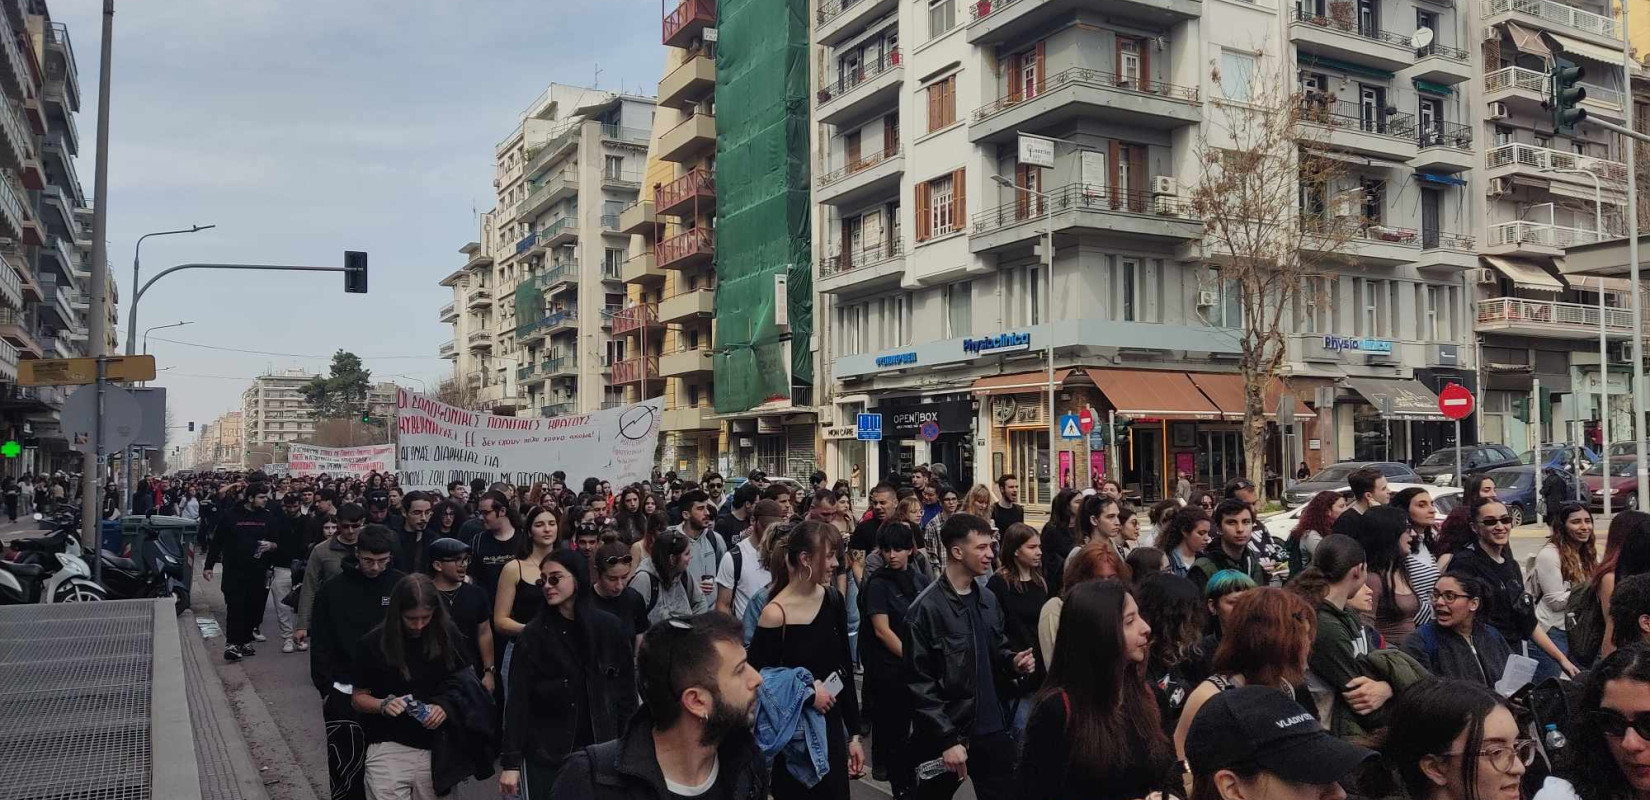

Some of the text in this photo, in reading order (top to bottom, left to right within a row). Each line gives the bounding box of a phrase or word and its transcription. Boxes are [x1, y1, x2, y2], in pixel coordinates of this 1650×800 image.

[963, 332, 1030, 353] Physioclinica
[397, 388, 408, 409] ΟΙ
[547, 414, 592, 430] ΚΡΑΤΟΥΣ
[893, 411, 938, 424] OPEN BOX
[401, 445, 429, 462] ΑΓΩΝΑΣ
[434, 446, 479, 465] ΔΙΑΡΚΕΙΑΣ
[484, 455, 499, 468] ΓΙΑ
[501, 471, 511, 485] ΜΕ
